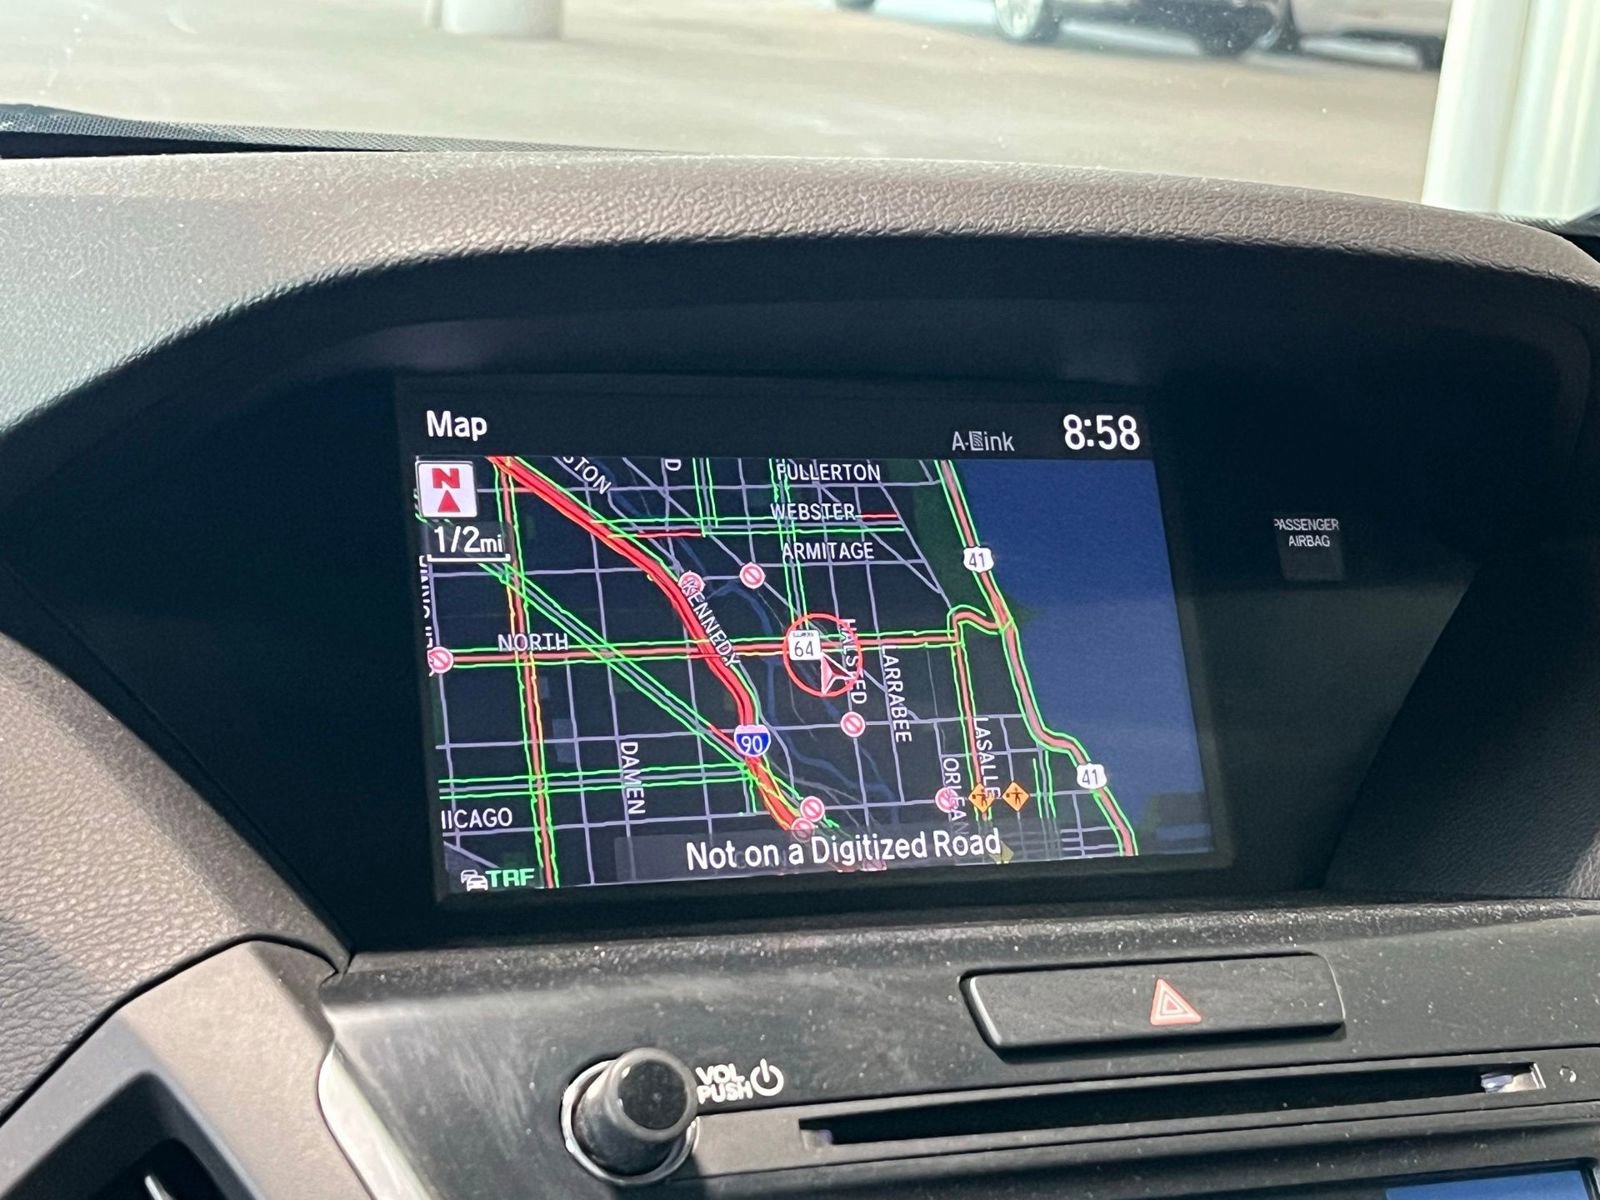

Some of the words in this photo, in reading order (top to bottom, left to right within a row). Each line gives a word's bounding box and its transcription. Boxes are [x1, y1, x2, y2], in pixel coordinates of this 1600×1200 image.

[426, 410, 488, 442] Map
[1062, 413, 1141, 451] 8:58
[431, 468, 461, 489] N
[776, 463, 881, 481] FULLERTON
[770, 503, 856, 520] WEBSTER
[1274, 518, 1340, 531] PASSENGER
[434, 525, 504, 553] 1/2mi
[1288, 535, 1331, 547] AIRBAG
[782, 542, 875, 560] ARMITAGE
[968, 551, 986, 569] 41
[681, 579, 741, 667] KENNEDY
[497, 633, 569, 651] NORTH
[794, 640, 815, 658] 64
[881, 645, 912, 743] LARRABEE
[741, 735, 763, 754] 90
[973, 716, 1001, 800] LASALLE
[620, 741, 646, 815] DAMEN
[1082, 768, 1099, 786] 41
[686, 840, 737, 871] Not
[744, 844, 780, 868] on
[788, 843, 804, 865] a
[811, 828, 927, 866] Digitized
[933, 827, 1001, 858] Road
[485, 867, 536, 888] TRF
[695, 1063, 746, 1086] VOL
[696, 1080, 754, 1105] PUSH
